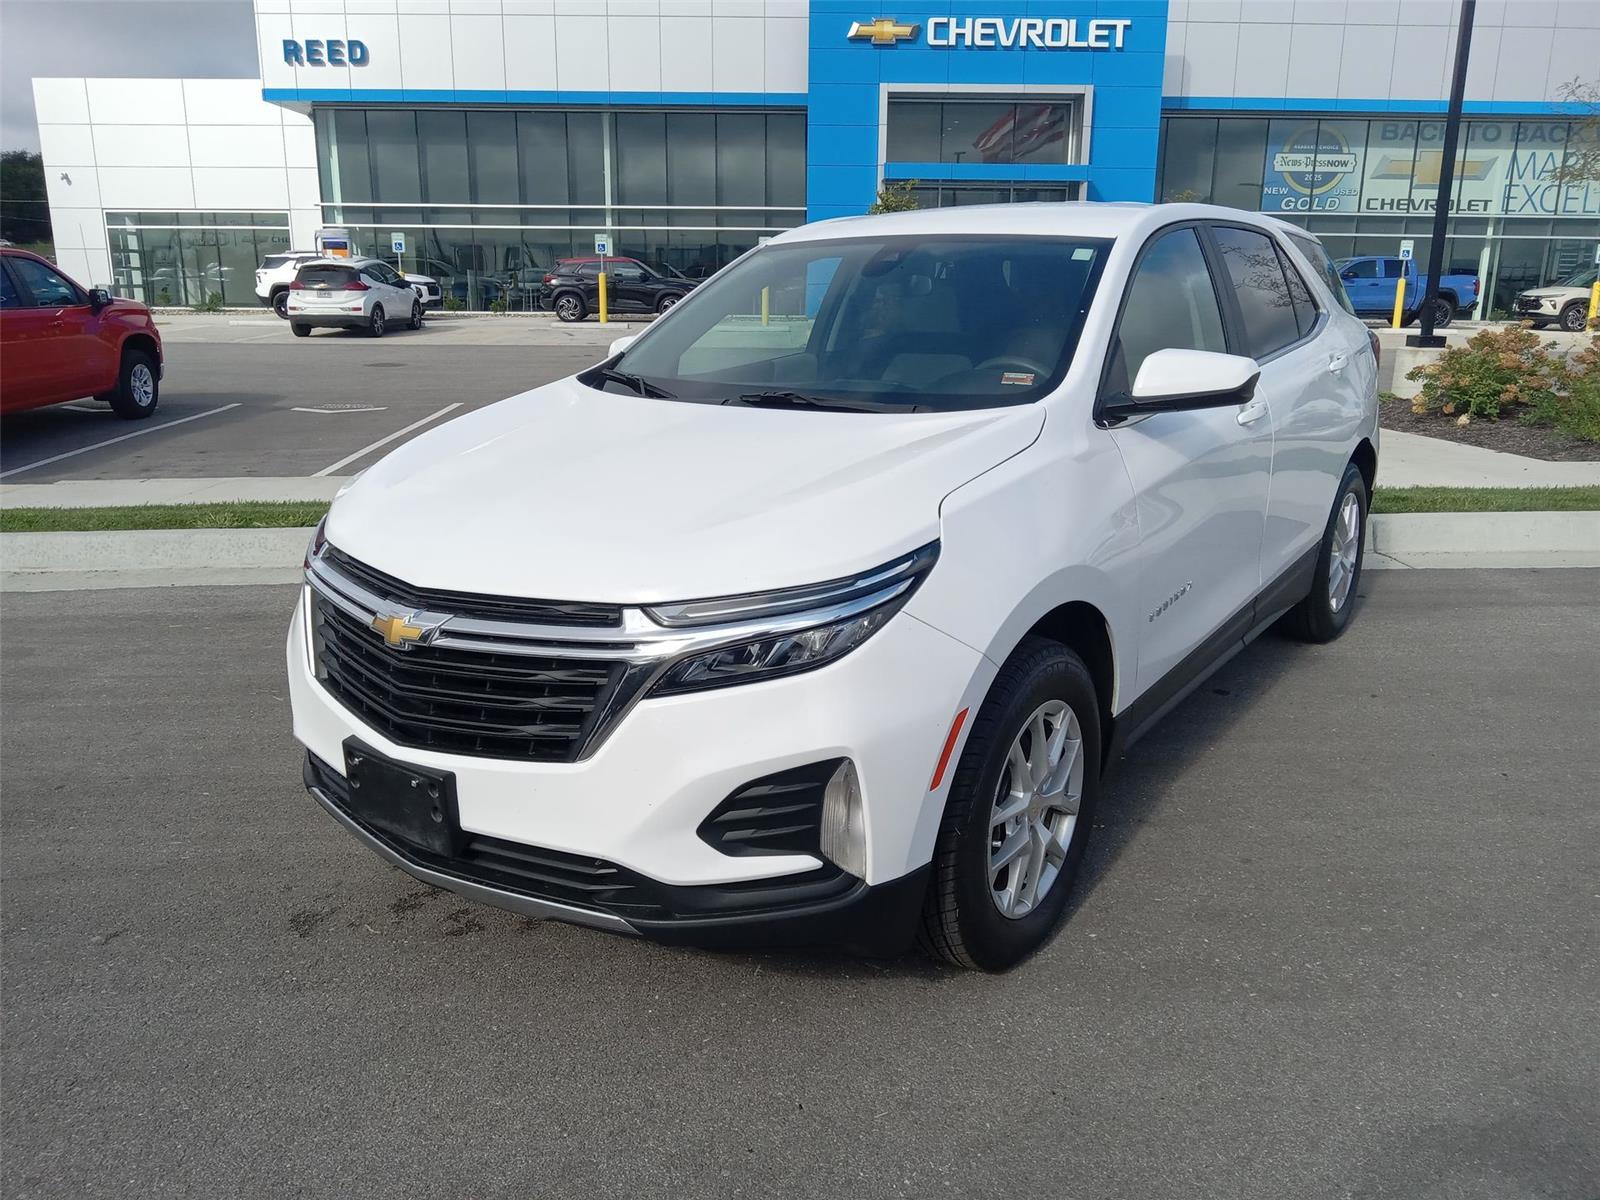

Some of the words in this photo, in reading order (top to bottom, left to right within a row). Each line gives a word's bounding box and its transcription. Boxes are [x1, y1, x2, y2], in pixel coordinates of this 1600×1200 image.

[926, 17, 1131, 48] CHEVROLET
[282, 39, 368, 66] REED
[1466, 124, 1502, 142] TO
[1263, 186, 1289, 195] NEW
[1333, 188, 1359, 197] USED
[1280, 196, 1341, 211] GOLD
